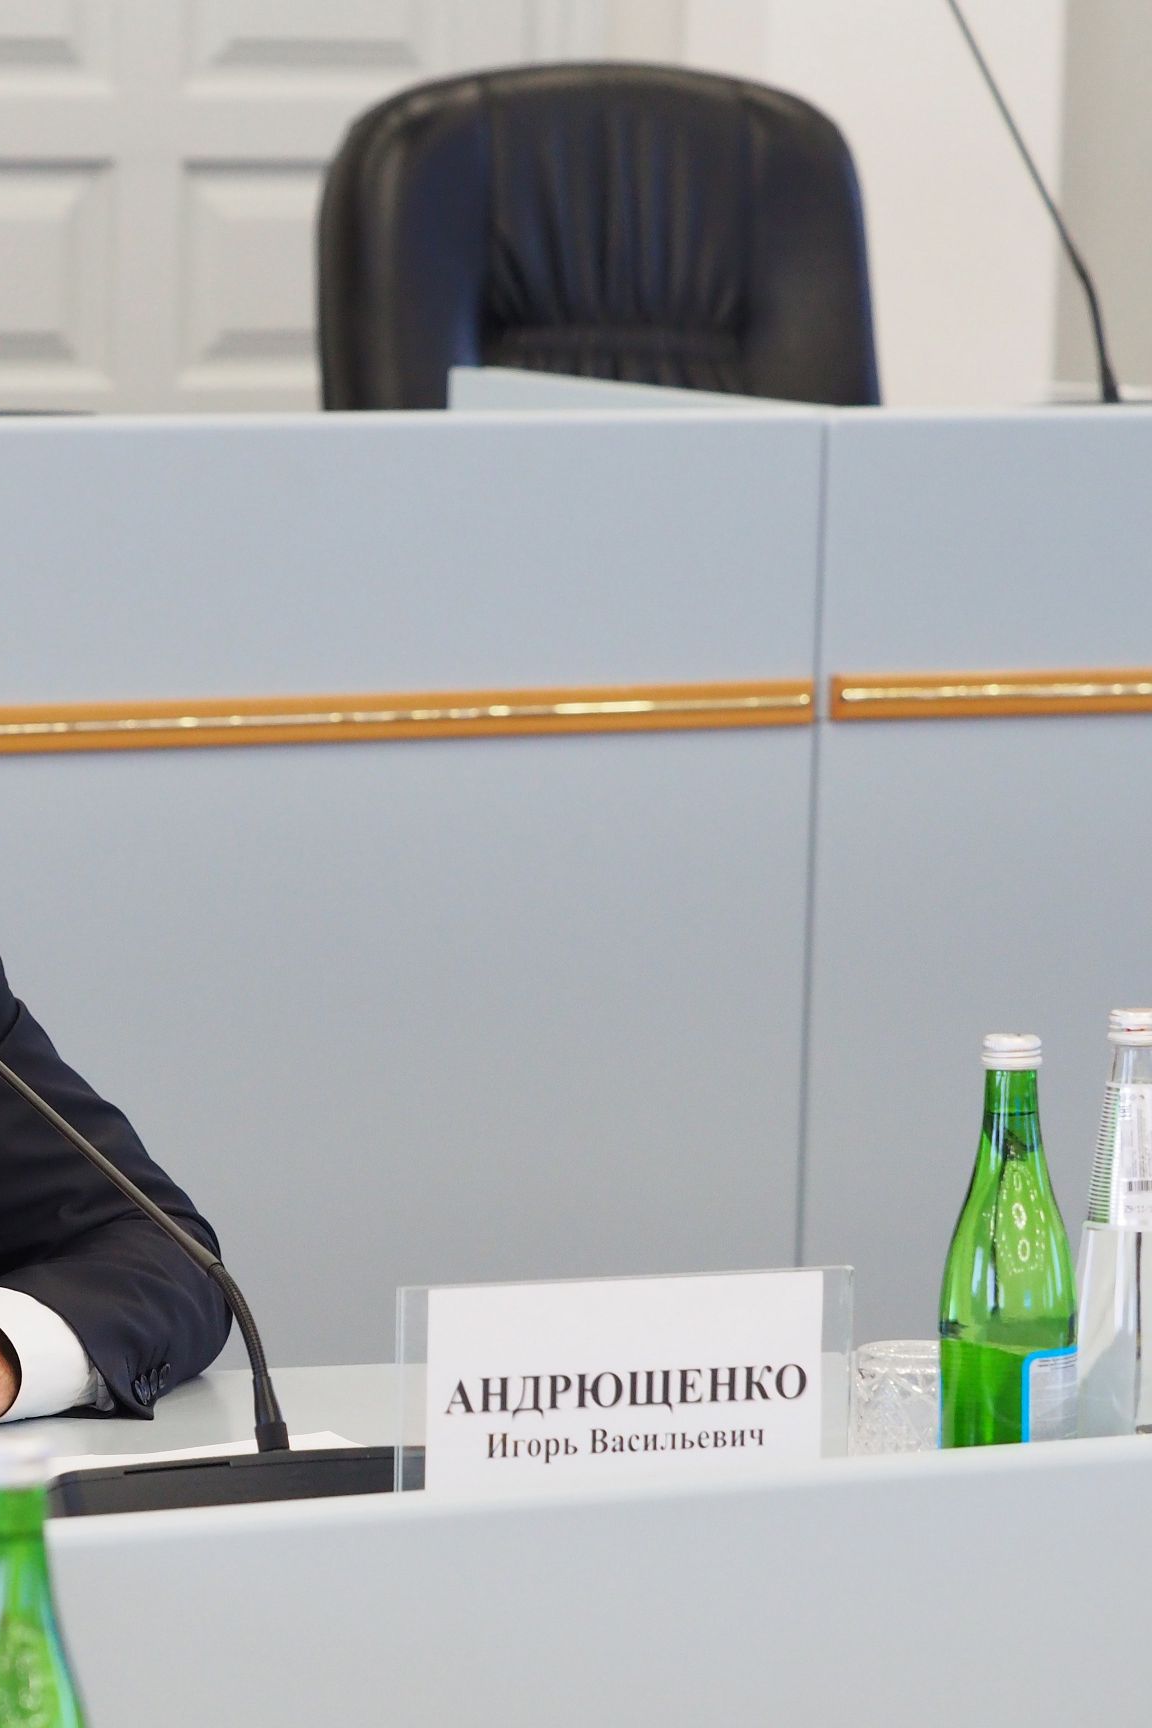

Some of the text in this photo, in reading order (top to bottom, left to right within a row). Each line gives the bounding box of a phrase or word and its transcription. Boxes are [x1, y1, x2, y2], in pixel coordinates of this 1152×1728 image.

[445, 1363, 808, 1418] АНДРЮЩЕНКО
[486, 1427, 765, 1463] Игорь Васильевич
